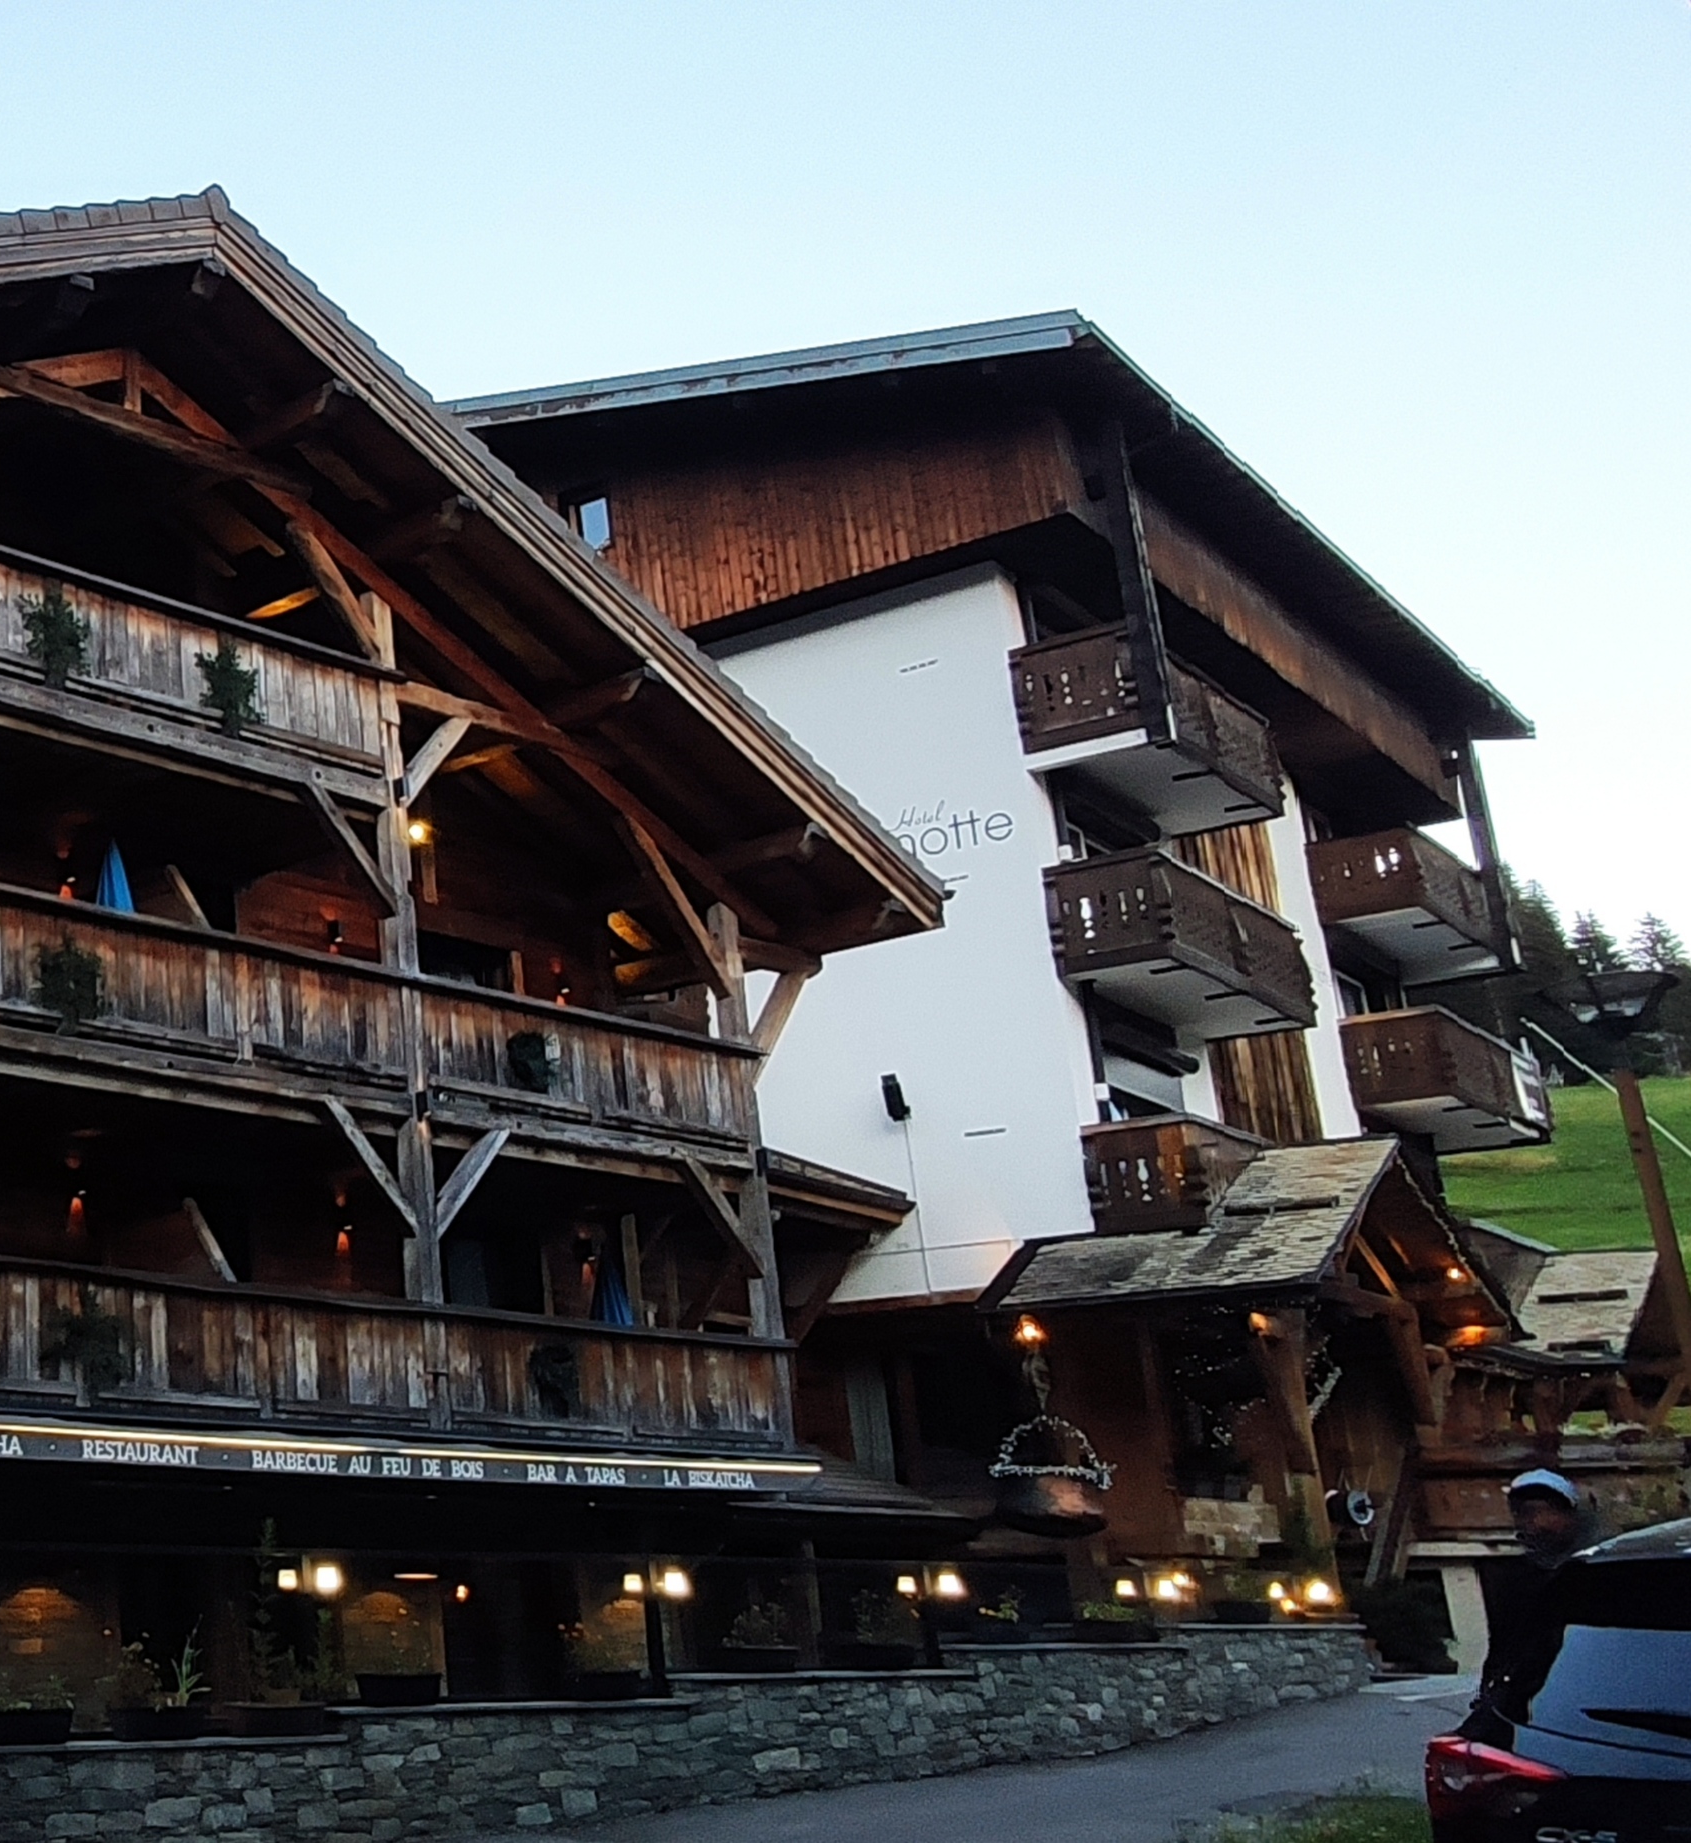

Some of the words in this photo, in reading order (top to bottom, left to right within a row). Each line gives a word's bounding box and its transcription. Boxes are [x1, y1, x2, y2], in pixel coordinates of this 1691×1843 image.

[888, 799, 946, 832] Hotel
[82, 1440, 199, 1466] RESTAURANT
[251, 1450, 338, 1474] BARBECUE
[347, 1455, 372, 1475] AU
[381, 1457, 412, 1477] FEU
[421, 1458, 442, 1478] DE
[450, 1459, 484, 1479] BOIS
[526, 1463, 557, 1483] BAR
[565, 1465, 577, 1483] A
[584, 1466, 626, 1486] TAPAS
[663, 1469, 682, 1487] LA
[688, 1470, 756, 1489] BISKATCHA
